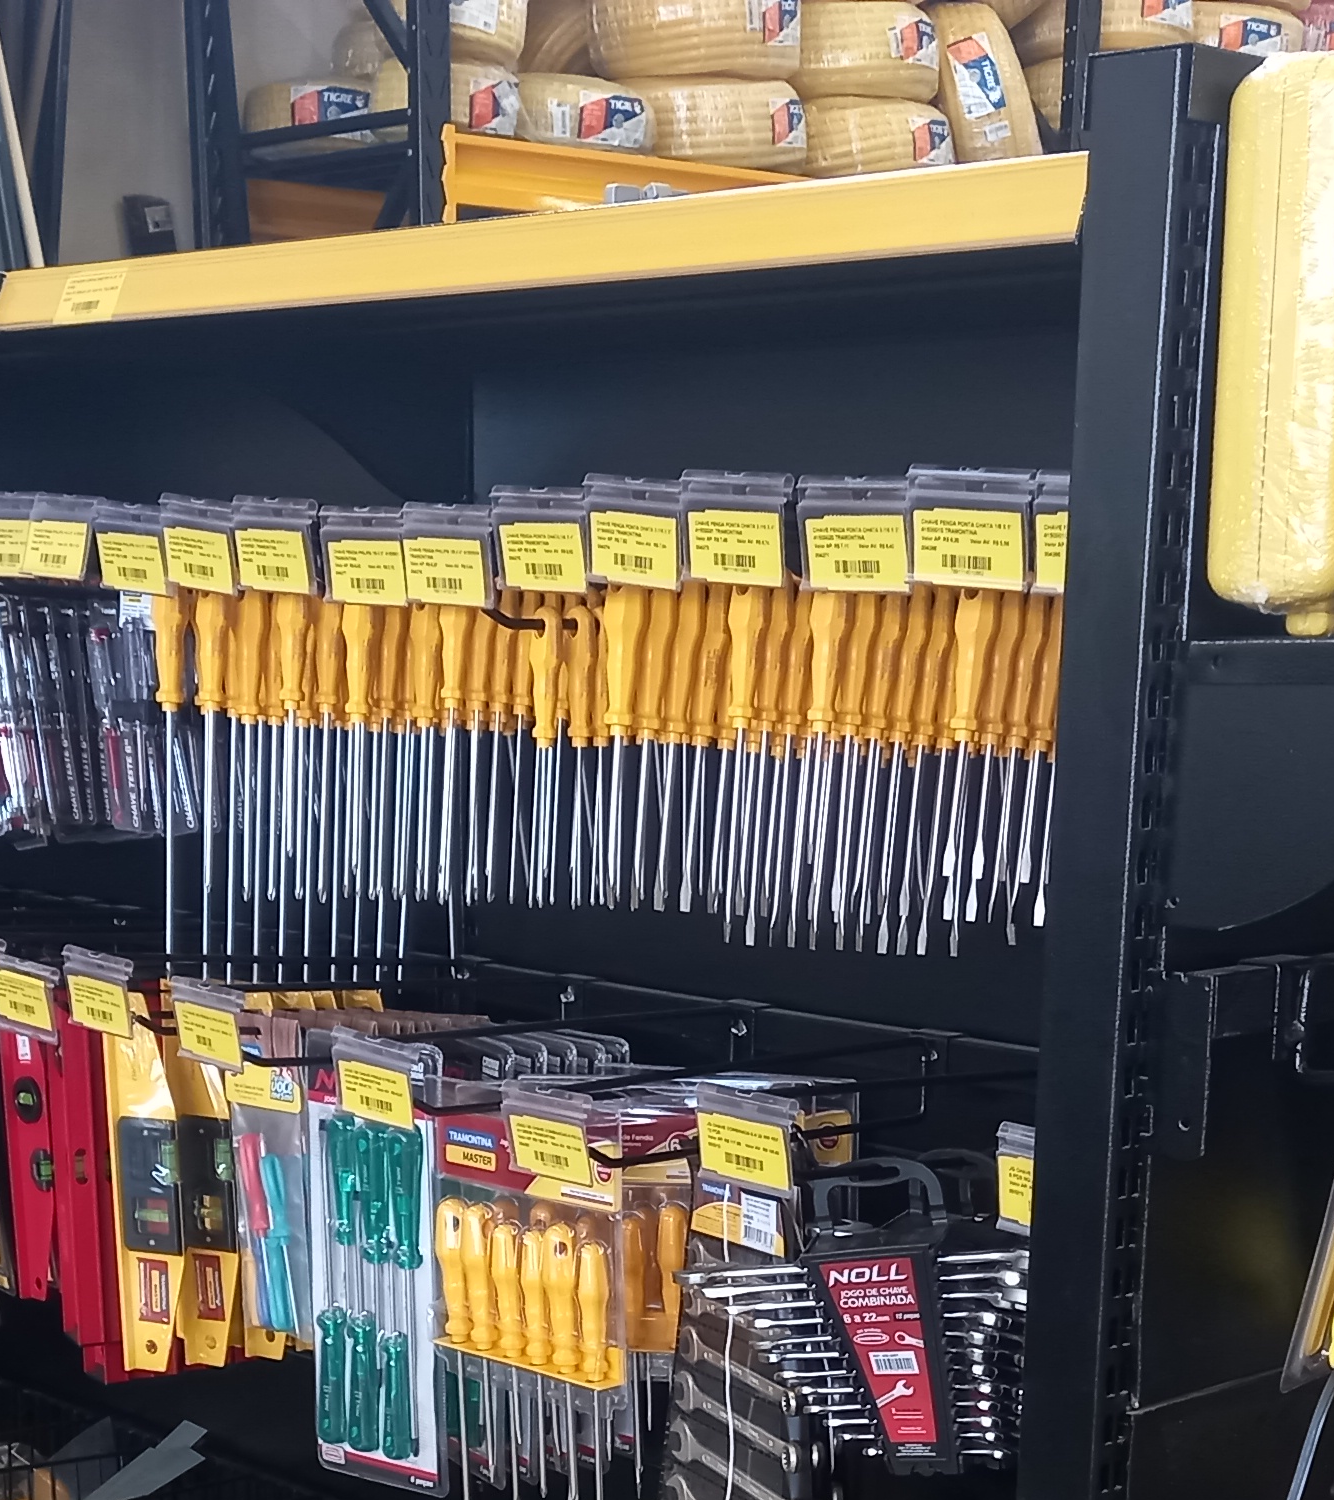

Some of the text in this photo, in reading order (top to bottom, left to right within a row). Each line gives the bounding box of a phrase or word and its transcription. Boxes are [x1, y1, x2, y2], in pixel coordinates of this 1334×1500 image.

[323, 91, 353, 105] TIGRE
[449, 1130, 494, 1148] TRAMONTINA
[462, 1151, 493, 1166] MASTER
[828, 1262, 908, 1288] NOLL
[840, 1286, 909, 1299] JOGO DE CHAVE
[839, 1293, 916, 1309] COMBINADA
[842, 1313, 852, 1324] 6
[853, 1314, 862, 1323] a
